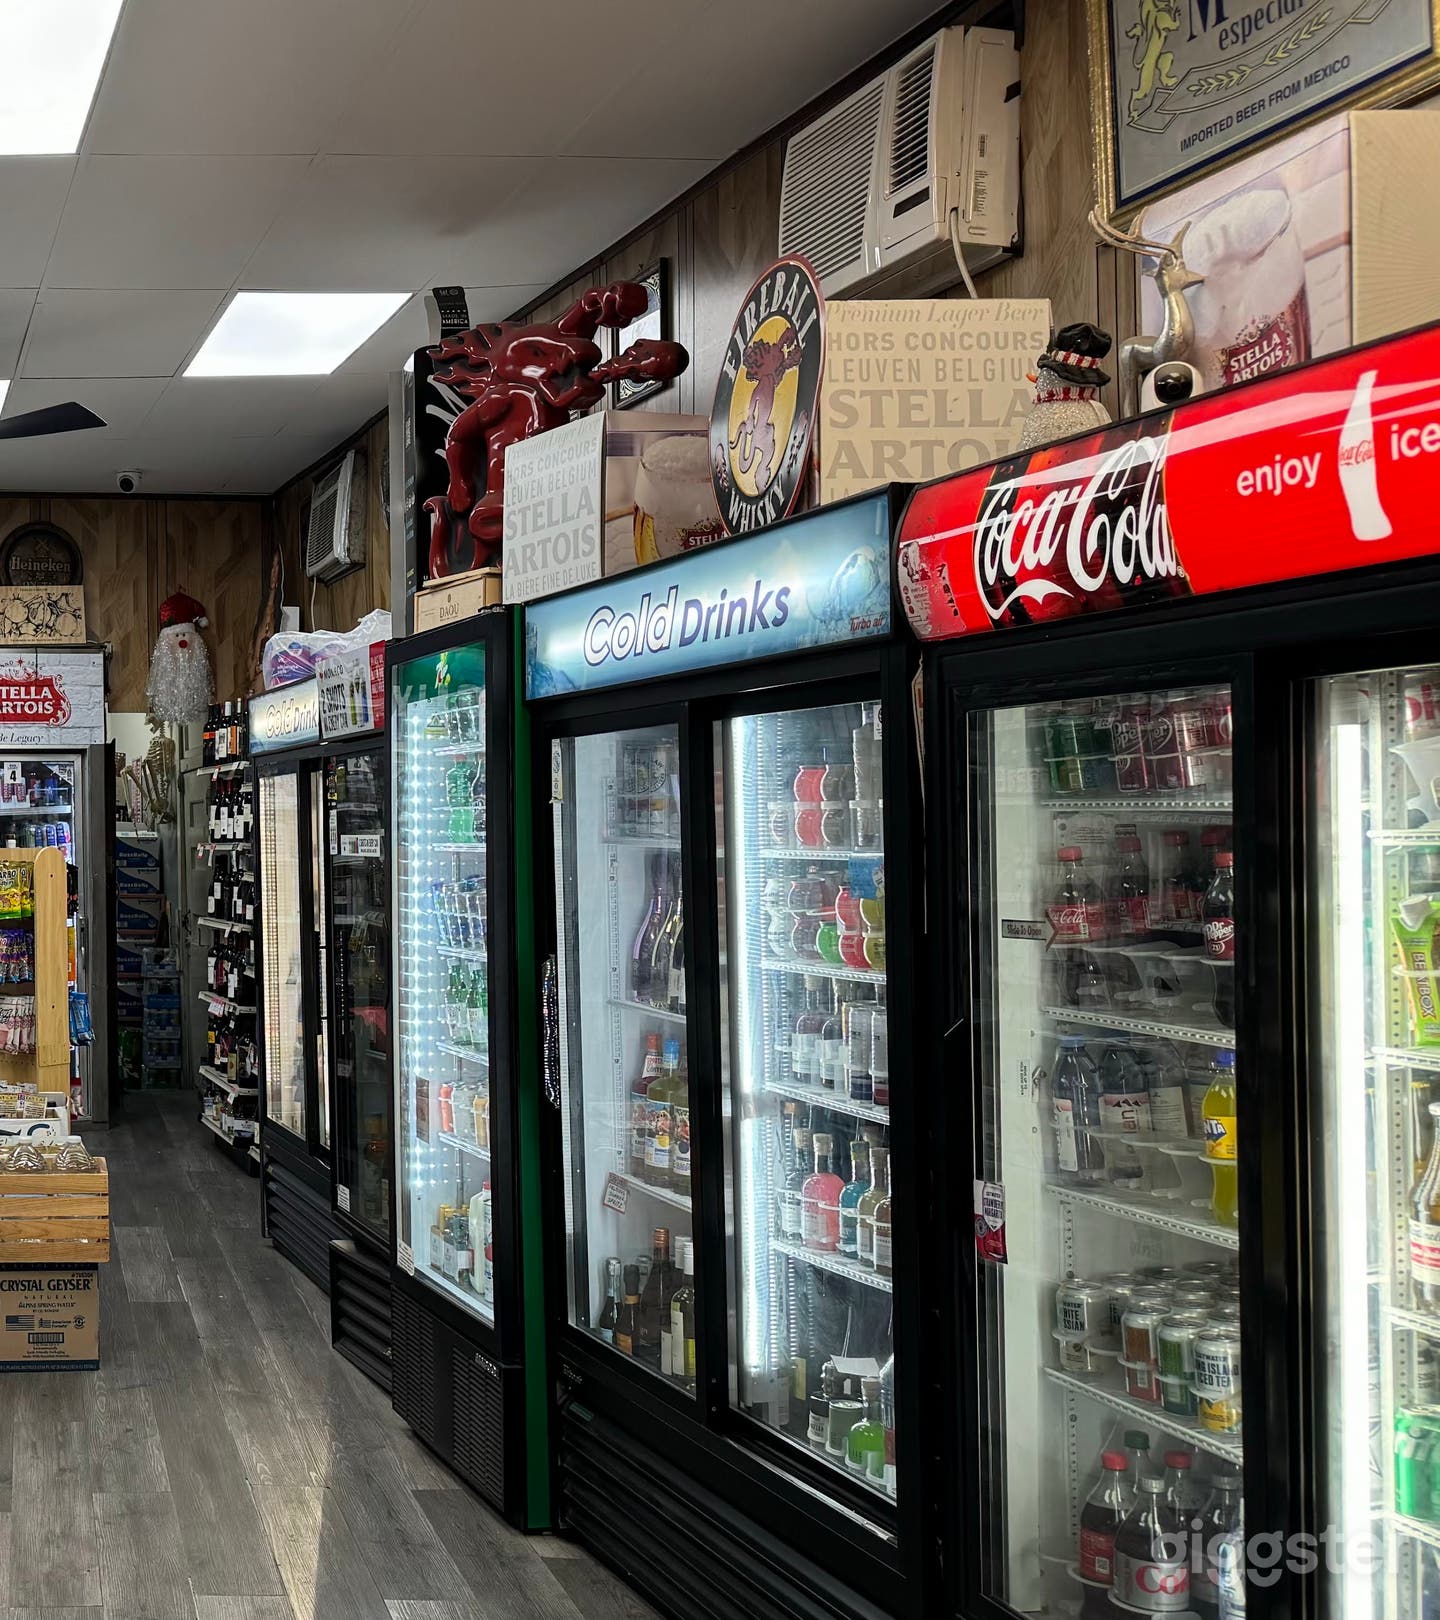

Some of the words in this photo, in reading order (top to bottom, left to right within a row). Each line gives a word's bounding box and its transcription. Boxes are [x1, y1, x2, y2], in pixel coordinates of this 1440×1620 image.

[1180, 115, 1234, 152] IMPORTED
[1236, 101, 1266, 125] BEER
[1269, 84, 1302, 108] FROM
[1304, 55, 1351, 89] MEXICO
[723, 271, 818, 384] FIREBALL
[827, 302, 922, 323] Premium
[927, 304, 991, 327] Lager
[995, 302, 1045, 322] Beer
[828, 331, 896, 352] HORS
[909, 331, 1046, 352] CONCOURS
[1230, 331, 1283, 372] STELLA
[828, 358, 922, 384] LEUVEN
[1233, 347, 1284, 385] ARTOIS
[537, 438, 597, 472] CONCOURS
[1236, 451, 1321, 497] enjoy
[506, 481, 544, 507] LEUVEN
[548, 457, 597, 494] BELGIUM
[505, 485, 595, 541] STELLA
[728, 479, 785, 532] WHISKY
[974, 435, 1179, 619] Coca-Cola
[10, 557, 71, 572] Heineken
[505, 522, 598, 579] ARTOIS
[542, 572, 560, 590] FINE
[576, 562, 597, 583] LUXE
[439, 603, 459, 618] DAOU
[584, 584, 680, 667] Cold
[679, 581, 791, 648] Drinks
[326, 683, 347, 713] SHOTS
[266, 697, 295, 740] Cold
[294, 703, 319, 732] Drink
[10, 732, 44, 745] Legacy
[9, 769, 17, 782] 4
[0, 1279, 44, 1292] CRYSTAL
[48, 1279, 93, 1292] GEYSER
